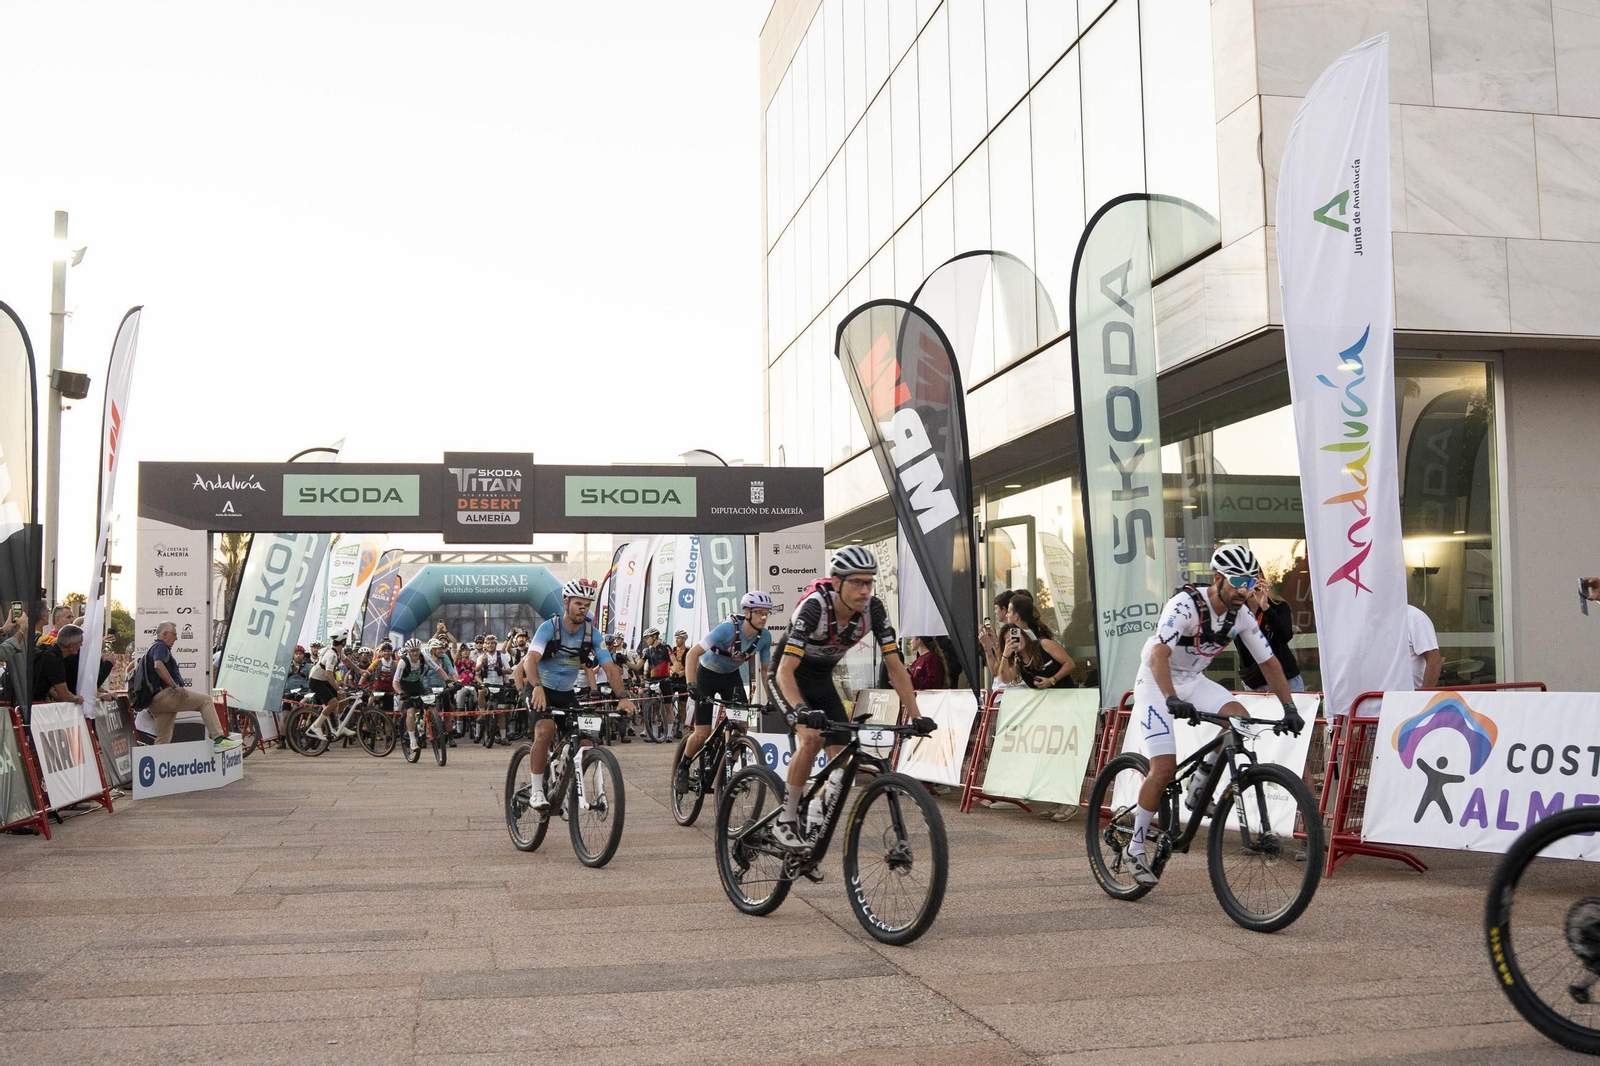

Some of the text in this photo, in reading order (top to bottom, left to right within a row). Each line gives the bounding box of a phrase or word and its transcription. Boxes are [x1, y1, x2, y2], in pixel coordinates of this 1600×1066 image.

[1350, 158, 1363, 256] Junta de Andalucía
[1315, 321, 1373, 598] Andalucía
[192, 473, 267, 492] Andalucía
[448, 467, 522, 493] TITAN
[457, 498, 522, 510] DESERT
[711, 506, 804, 515] DIPUTACIÓN DE ALMERÍA
[465, 513, 512, 523] ALMERÍA
[443, 574, 529, 586] UNIVERSAE
[443, 586, 473, 594] Instituto
[474, 586, 505, 594] Superior
[248, 668, 269, 678] Cycling
[732, 709, 741, 717] 22
[583, 717, 594, 725] 44
[870, 731, 883, 741] 28
[158, 756, 216, 779] Cleardent
